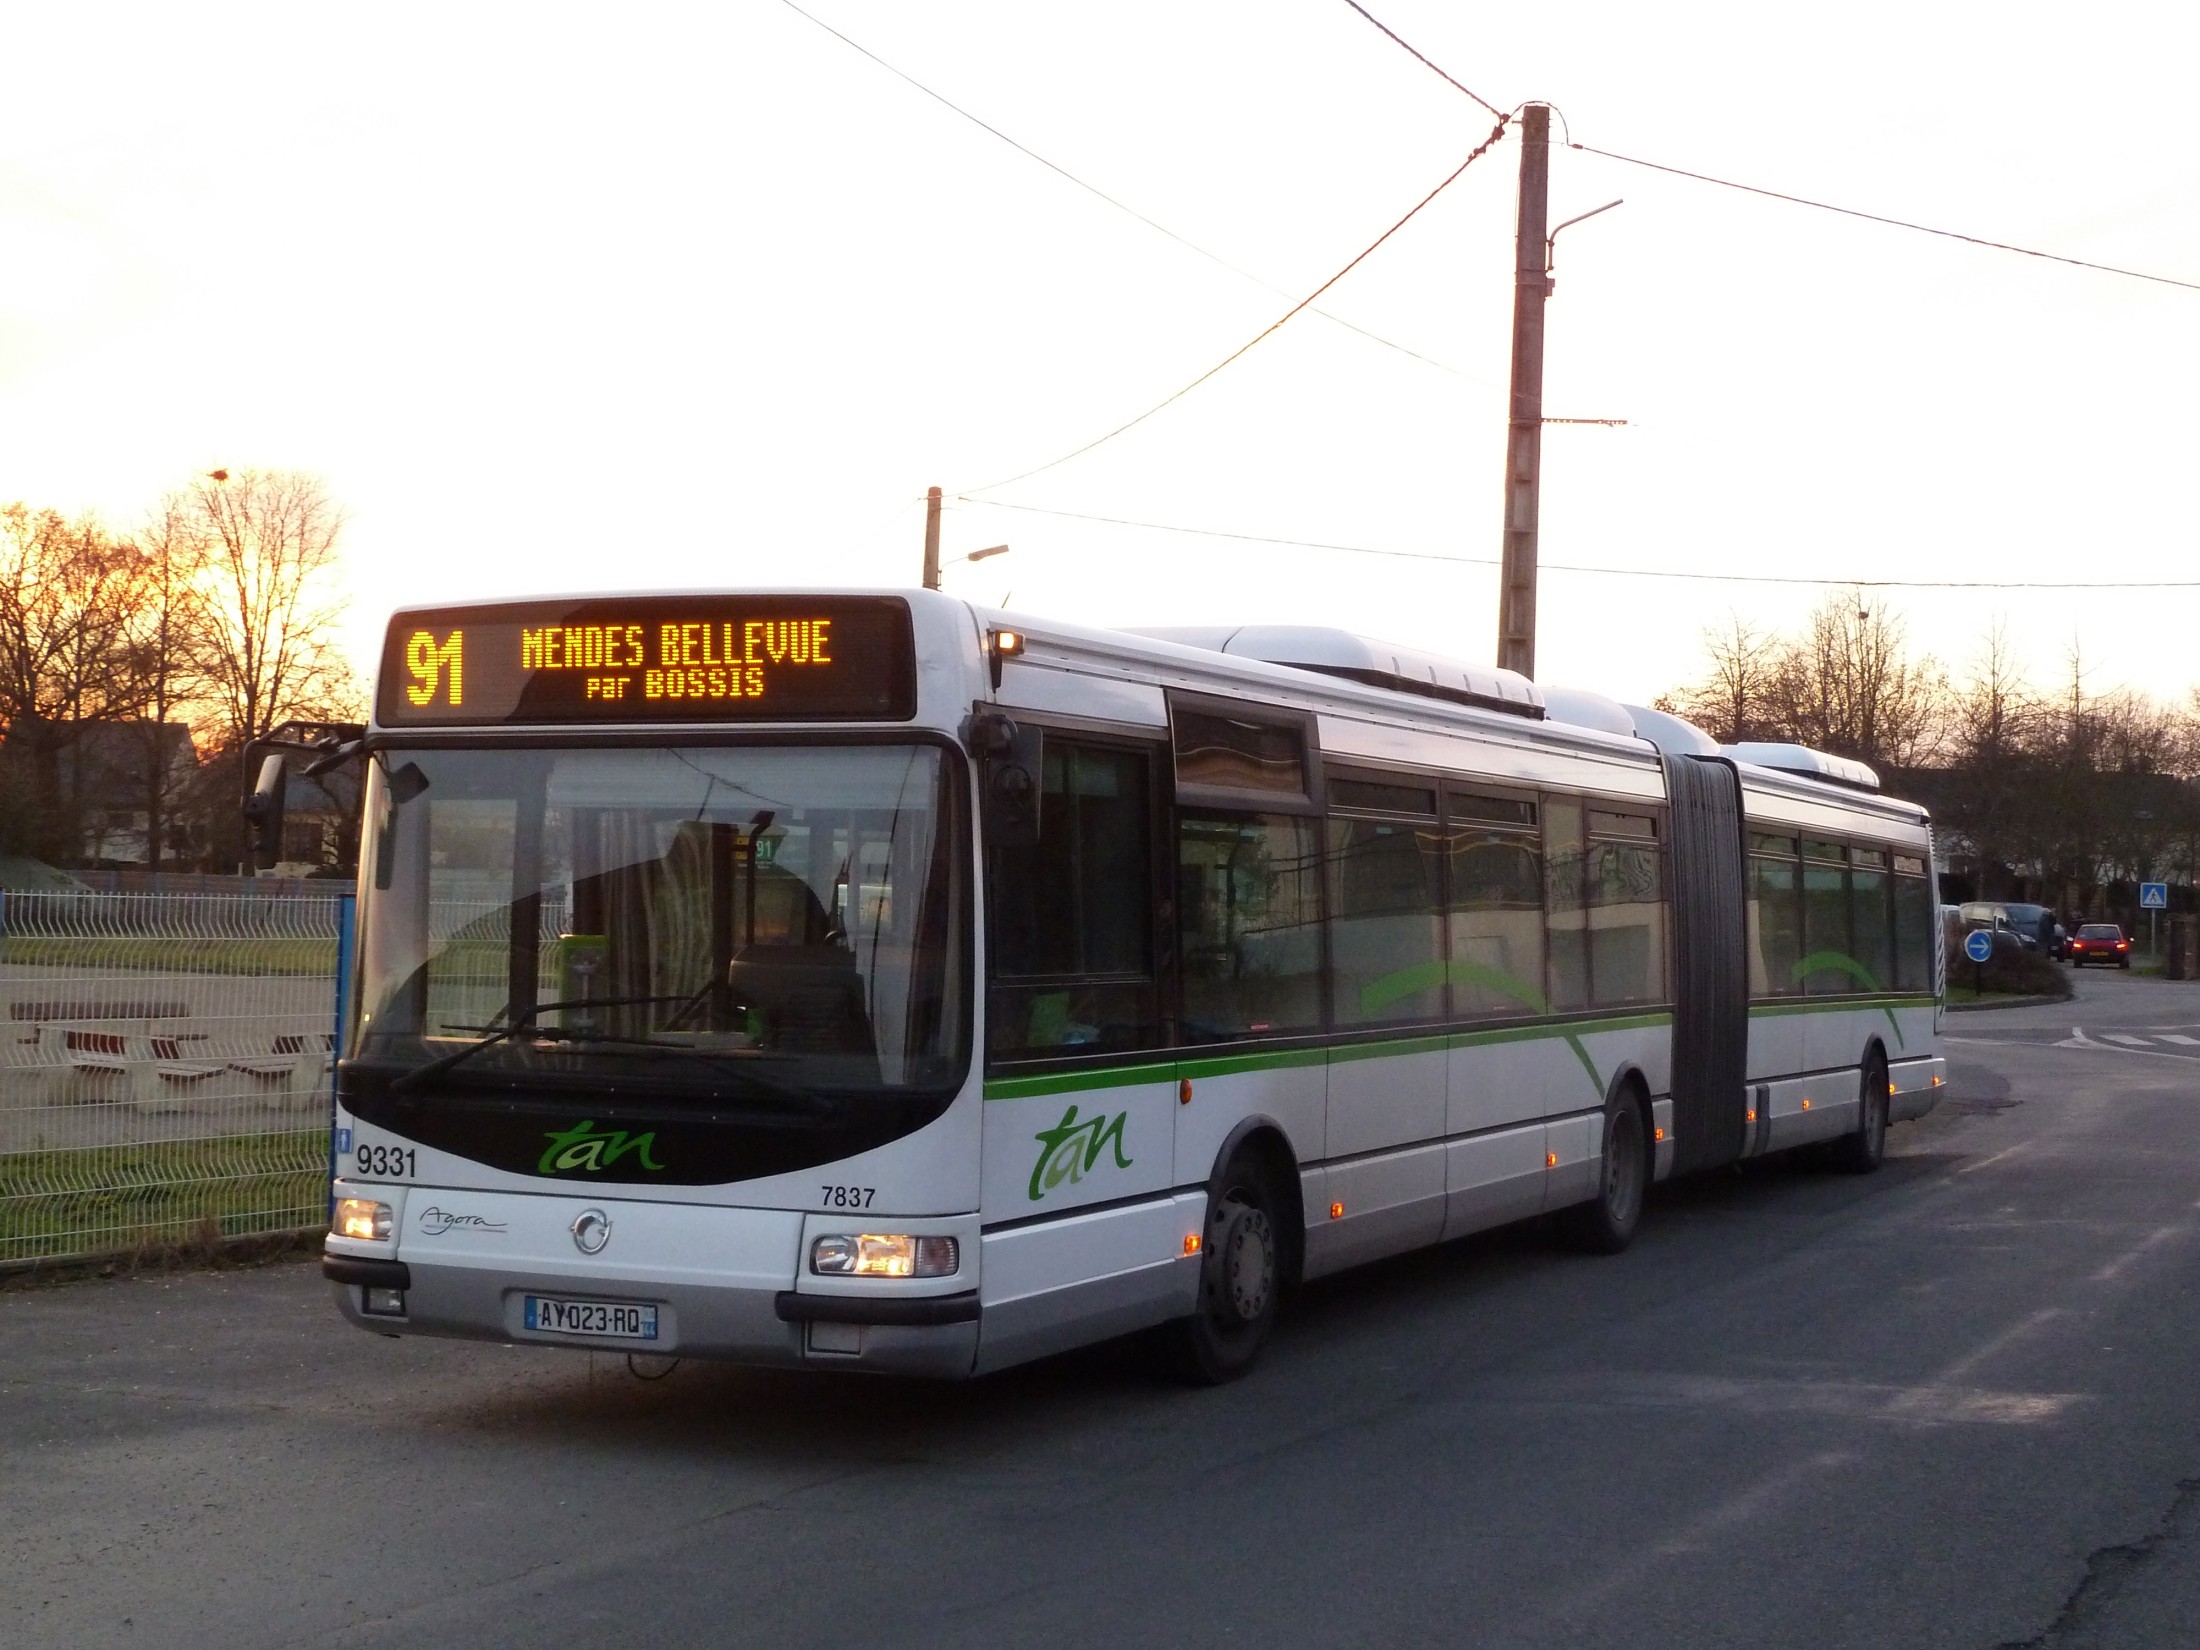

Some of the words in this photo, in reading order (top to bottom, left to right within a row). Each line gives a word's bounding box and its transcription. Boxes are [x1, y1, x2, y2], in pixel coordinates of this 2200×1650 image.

[521, 626, 644, 669] MENDES
[661, 619, 833, 668] BELLEVUE
[405, 630, 464, 706] 91
[645, 668, 765, 698] BOSSIS
[357, 1144, 415, 1178] 9331
[537, 1120, 666, 1174] tan
[1028, 1105, 1133, 1200] tan
[821, 1186, 876, 1208] 7837
[419, 1206, 508, 1236] Agora
